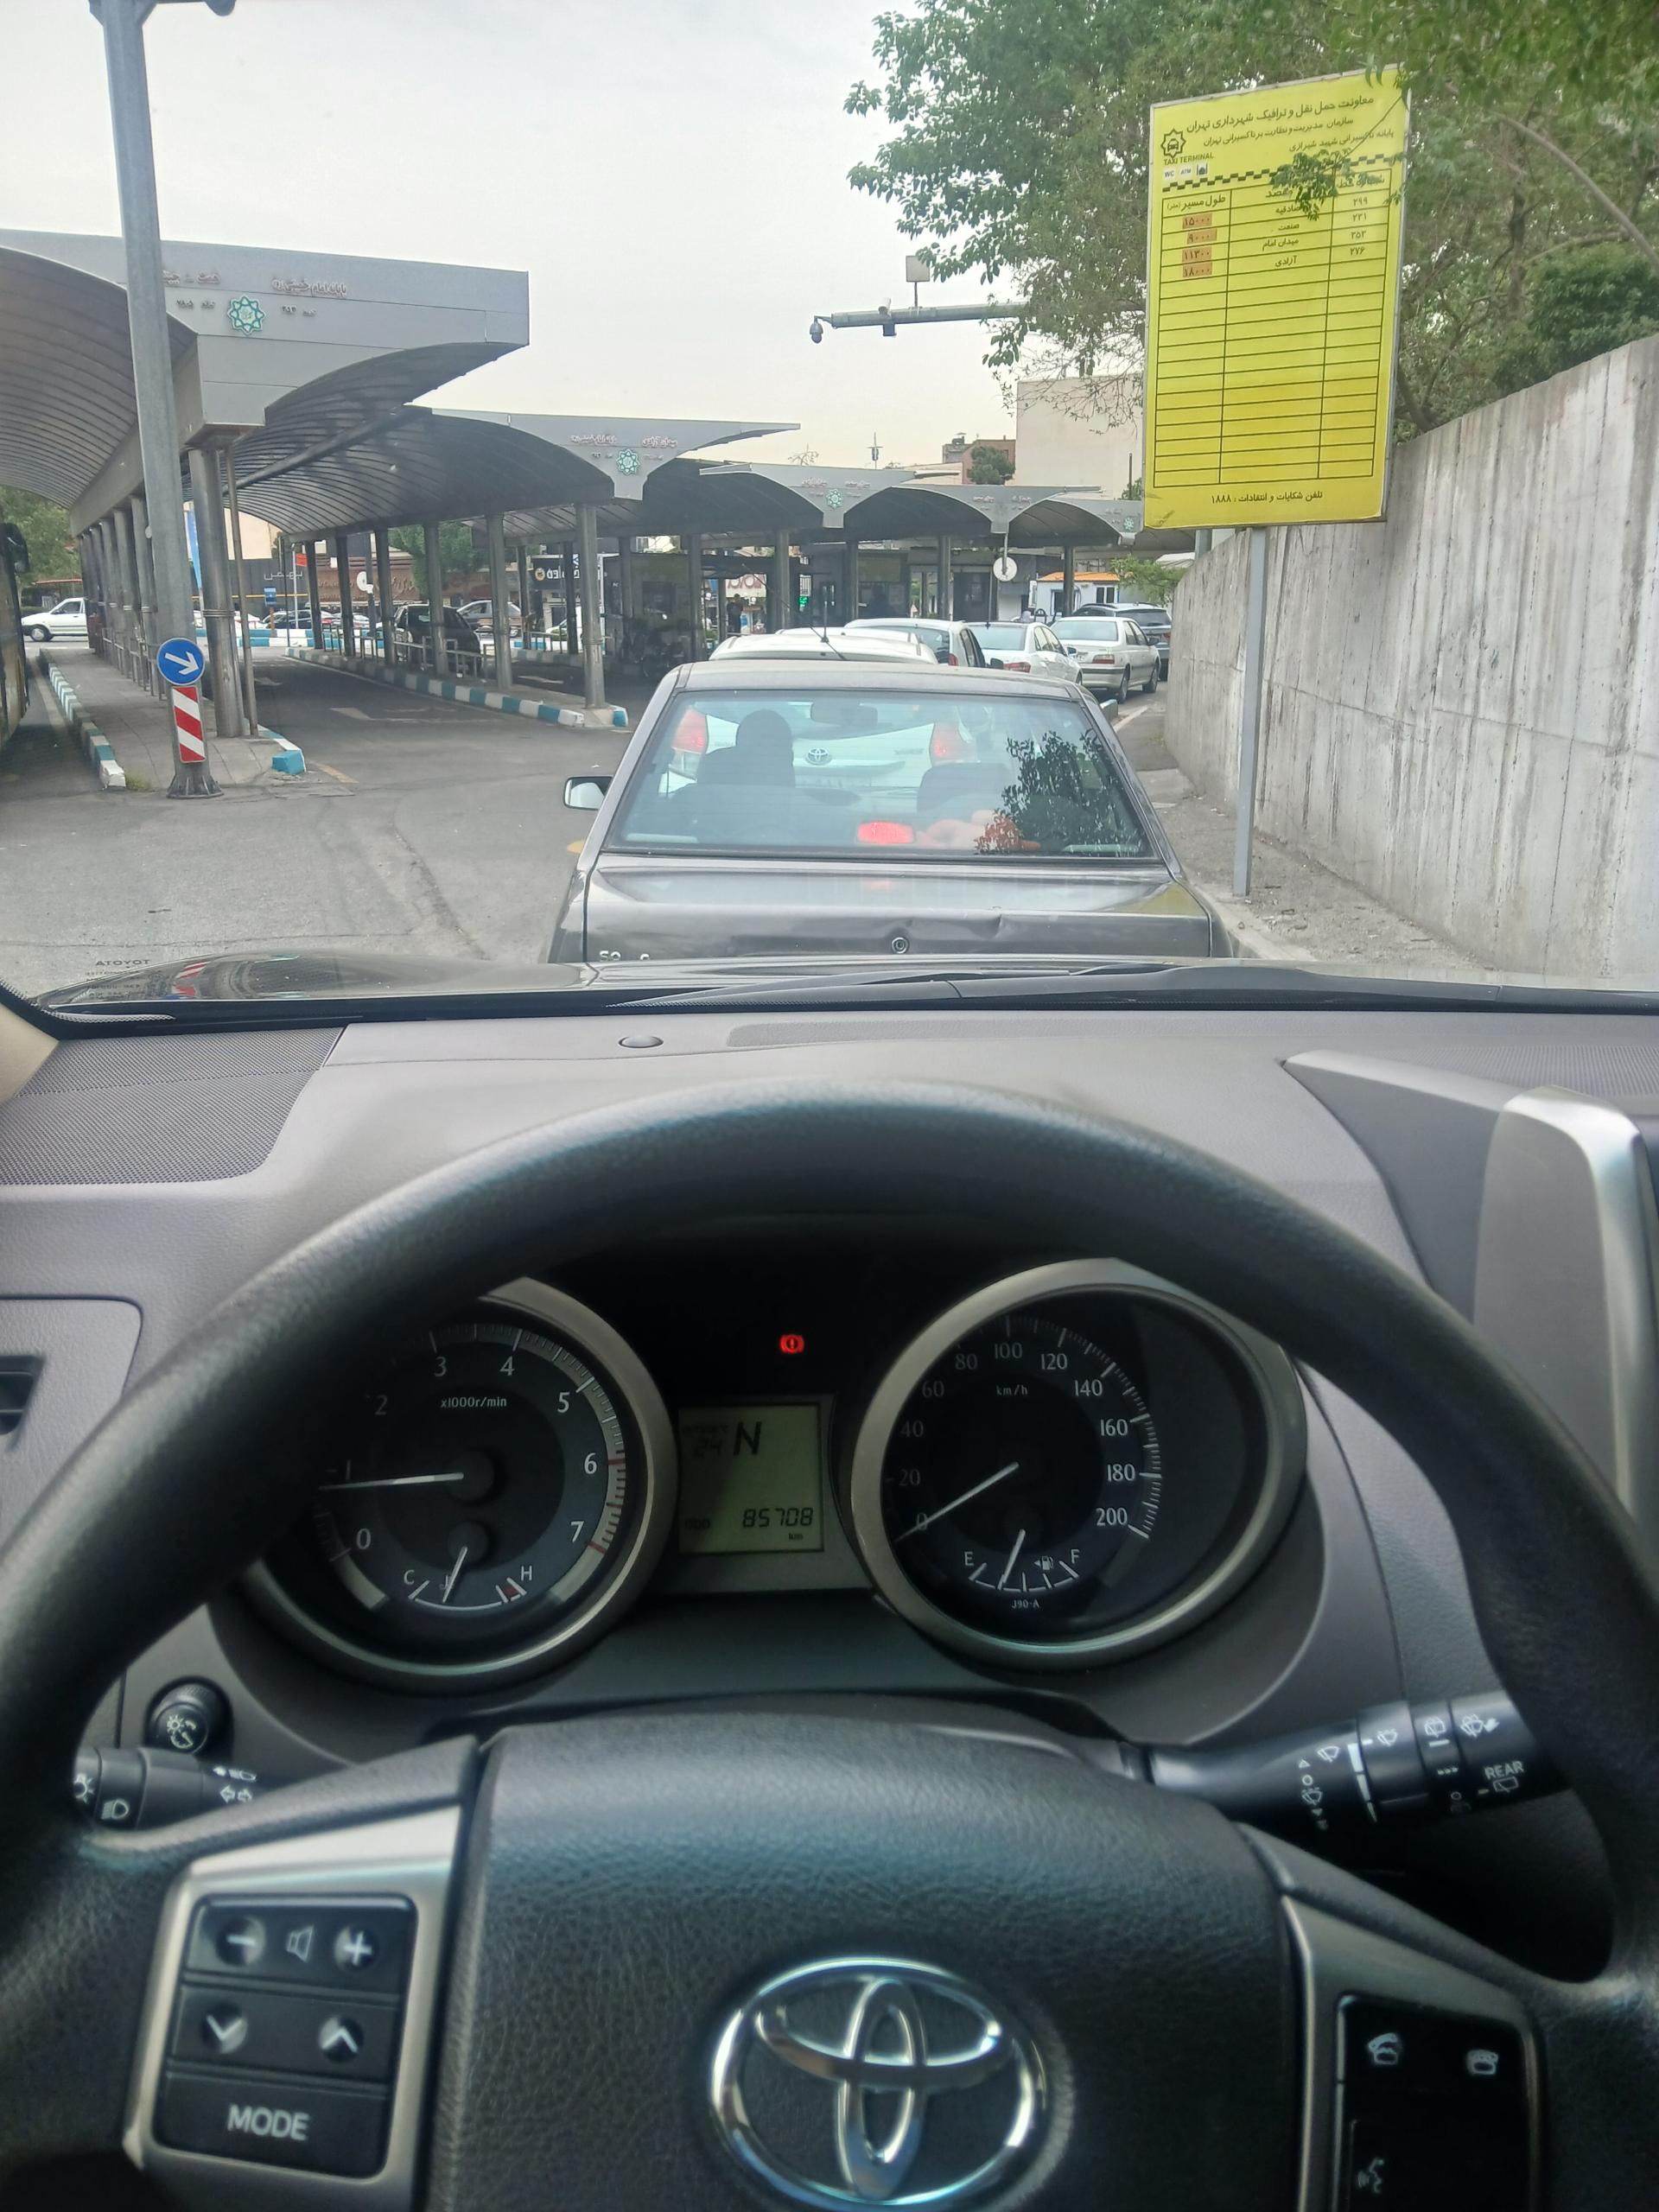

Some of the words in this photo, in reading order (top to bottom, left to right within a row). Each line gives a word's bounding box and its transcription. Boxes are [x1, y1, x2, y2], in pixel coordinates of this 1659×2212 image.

[1315, 101, 1335, 115] حمل
[1338, 95, 1374, 110] معاونت
[1256, 107, 1287, 121] ترافیک
[1287, 110, 1294, 118] و
[1296, 104, 1313, 118] نقل
[1186, 120, 1210, 133] تهران
[1212, 112, 1253, 129] شهرداری
[1294, 123, 1323, 132] مدیریت
[1326, 117, 1353, 129] سازمان
[1376, 129, 1394, 138] پایانه
[1204, 137, 1222, 147] تهران
[1319, 138, 1338, 147] شهید
[1179, 152, 1214, 164] TERMINAL
[1181, 200, 1205, 212] مسیر
[1205, 194, 1226, 207] طول
[1184, 216, 1211, 226] ۱۵۰۰۰
[1188, 234, 1211, 243] ۹۰۰۰
[1262, 238, 1276, 251] امام
[1278, 238, 1300, 248] میدان
[1274, 255, 1298, 268] آزادی
[1184, 267, 1211, 277] ۱۸۰۰۰
[1211, 493, 1232, 504] ۱۸۸۸
[1237, 492, 1268, 503] انتقادات
[1268, 495, 1274, 504] و
[1276, 491, 1303, 503] شکایات
[1305, 491, 1323, 502] تلفن
[995, 1342, 1023, 1360] 100
[434, 1356, 448, 1377] 3
[499, 1355, 516, 1376] 4
[955, 1353, 979, 1370] 80
[1040, 1352, 1069, 1370] 120
[922, 1380, 945, 1398] 60
[995, 1384, 1028, 1396] km/h
[1074, 1378, 1103, 1397] 140
[374, 1394, 388, 1415] 2
[556, 1391, 570, 1414] 5
[900, 1420, 925, 1438] 40
[1100, 1418, 1128, 1436] 160
[734, 1421, 762, 1456] N
[583, 1452, 598, 1475] 6
[899, 1468, 921, 1487] 20
[1107, 1463, 1136, 1483] 180
[742, 1507, 814, 1529] 85708
[916, 1512, 929, 1532] 0
[1095, 1507, 1128, 1527] 200
[355, 1528, 372, 1550] 0
[569, 1521, 585, 1543] 7
[788, 1532, 804, 1541] km
[963, 1551, 975, 1567] E
[1071, 1548, 1080, 1564] F
[403, 1568, 416, 1586] C
[520, 1565, 533, 1581] H
[1484, 1760, 1524, 1780] REAR
[227, 2102, 310, 2141] MODE
